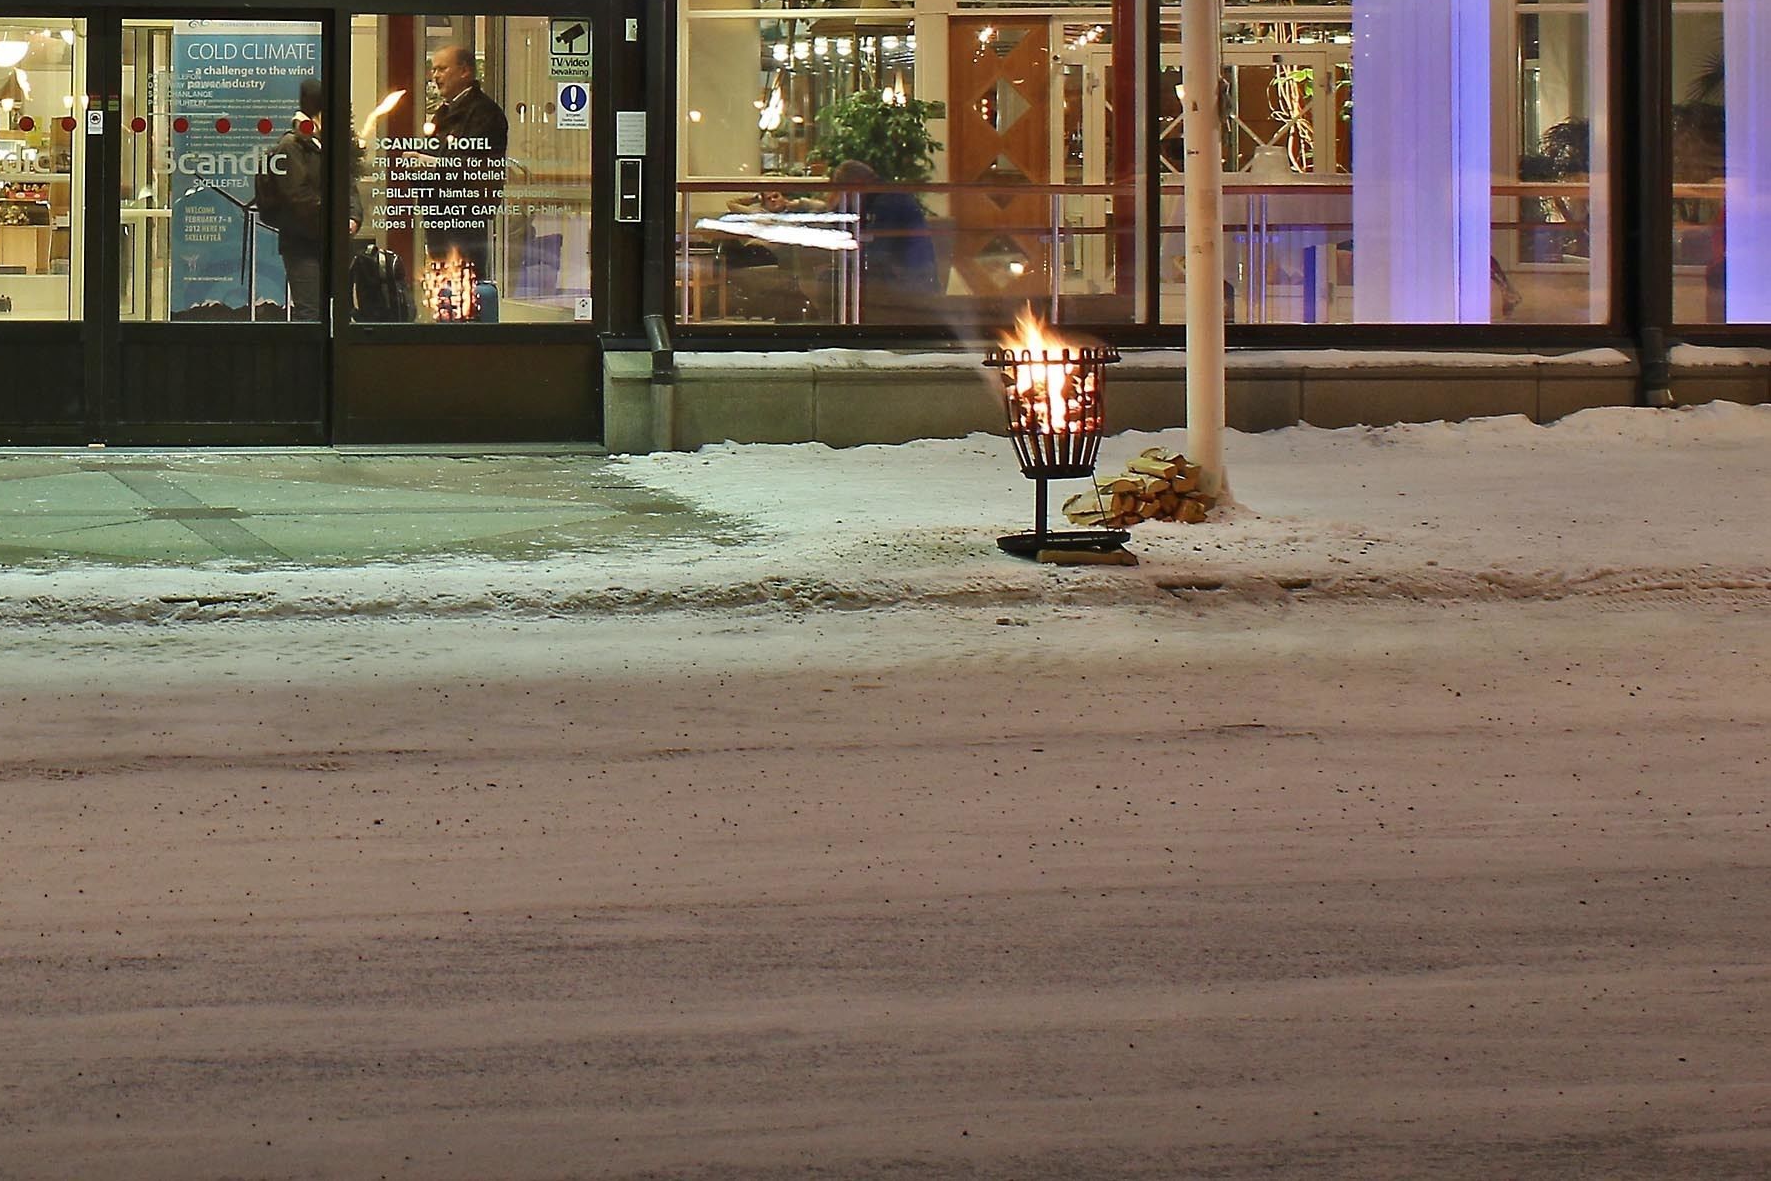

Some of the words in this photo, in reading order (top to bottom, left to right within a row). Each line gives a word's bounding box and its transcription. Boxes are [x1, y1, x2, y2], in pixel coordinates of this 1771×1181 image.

[187, 43, 238, 60] COLD
[242, 43, 316, 60] CLIMATE
[203, 65, 254, 77] challenge
[256, 66, 267, 75] to
[269, 65, 284, 75] the
[286, 65, 314, 75] wind
[551, 68, 589, 76] bevakning
[374, 137, 441, 150] SCANDIC
[447, 137, 492, 150] HOTEL
[160, 146, 288, 175] Scandic
[372, 157, 391, 167] FRI
[466, 157, 482, 167] för
[193, 175, 249, 188] SKELLEFTEÅ
[372, 171, 386, 182] på
[390, 170, 441, 181] baksidan
[445, 173, 459, 181] av
[463, 170, 508, 181] hotellet.
[372, 187, 435, 199] P-BILJETT
[438, 187, 480, 199] hämtas
[185, 206, 215, 214] WELCOME
[372, 205, 467, 216] AVGIFTSBELAGT
[372, 219, 406, 230] köpes
[419, 219, 485, 231] receptionen
[185, 233, 222, 242] SKELLEFTEÅ
